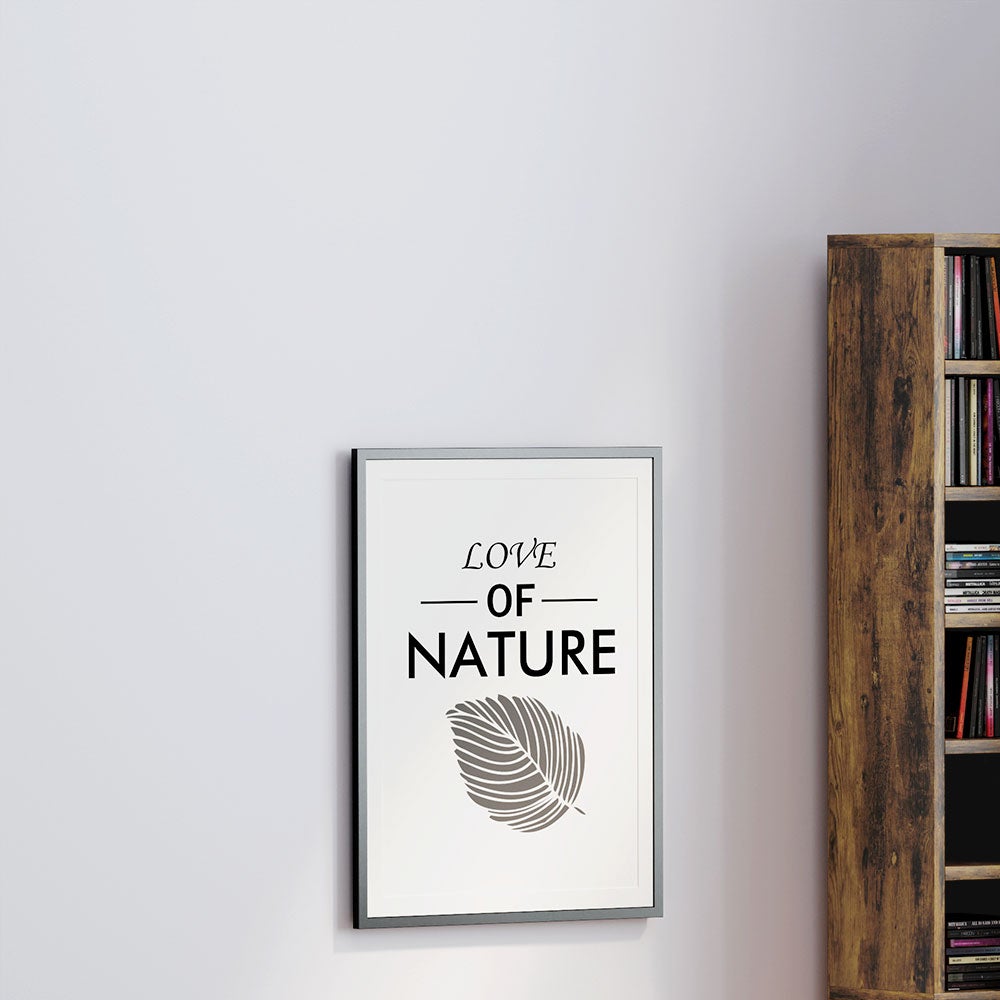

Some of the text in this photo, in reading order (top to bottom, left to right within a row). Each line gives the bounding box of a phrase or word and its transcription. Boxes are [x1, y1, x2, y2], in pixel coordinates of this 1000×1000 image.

[461, 537, 557, 570] LOVE
[486, 583, 536, 618] OF
[408, 628, 616, 679] NATURE
